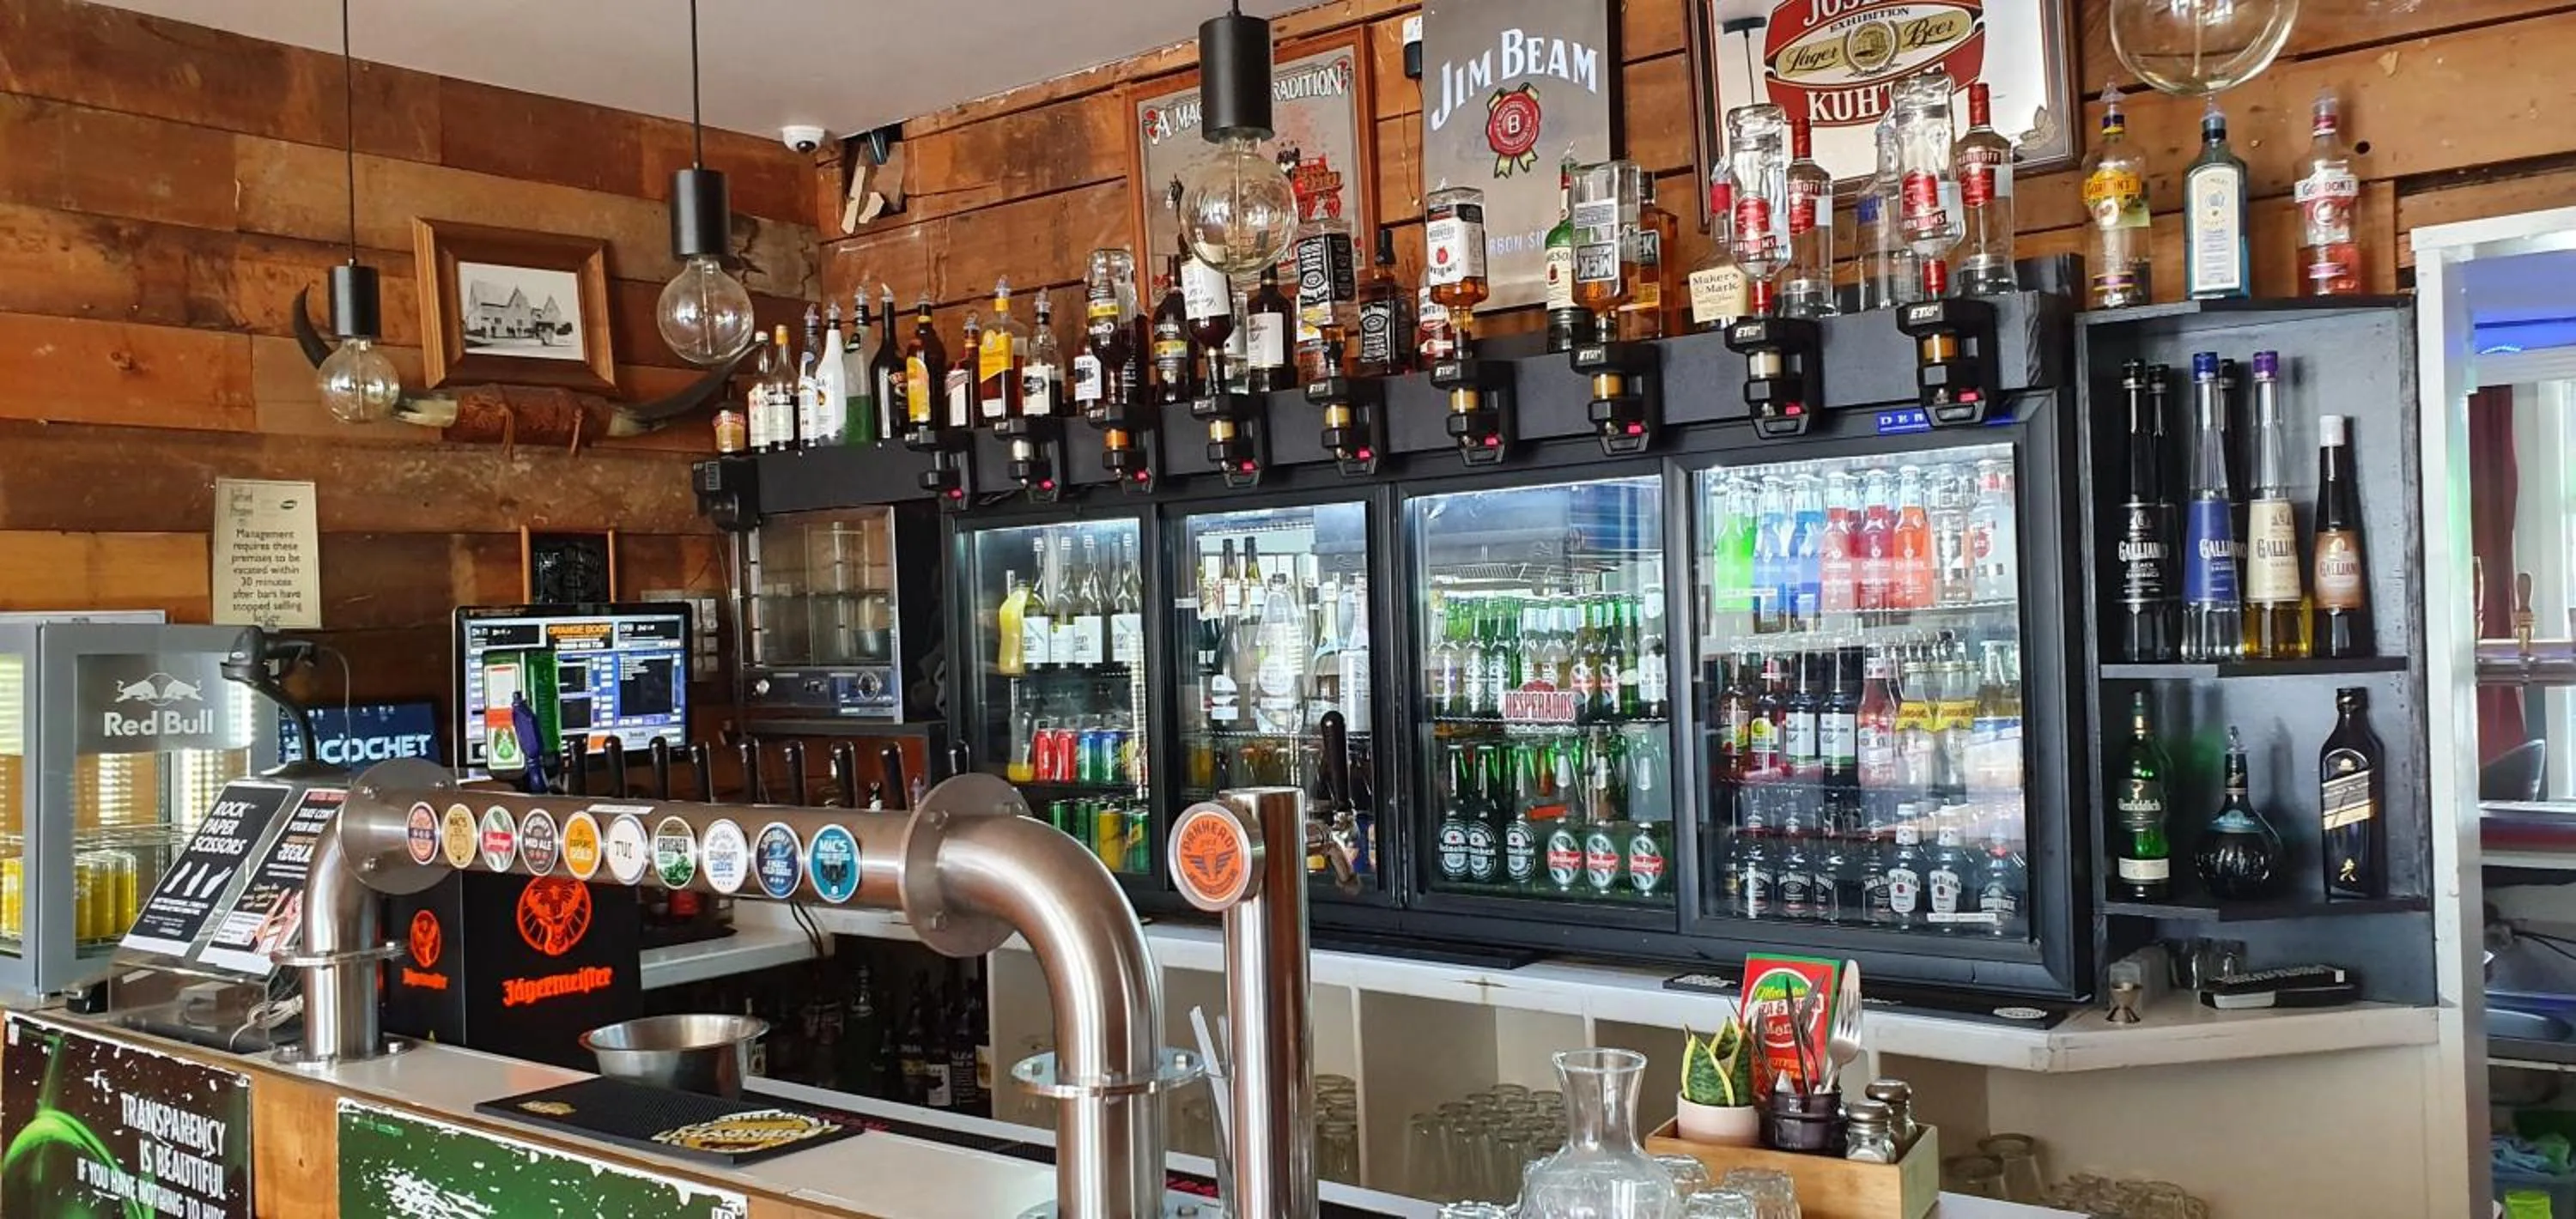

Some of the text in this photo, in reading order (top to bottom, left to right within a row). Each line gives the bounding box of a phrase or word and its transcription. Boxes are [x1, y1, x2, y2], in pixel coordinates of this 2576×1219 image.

[1830, 7, 1910, 33] EXHIBITION
[1903, 17, 1956, 48] Beer
[1431, 27, 1598, 131] JIM BEAM
[1507, 114, 1521, 134] B
[2087, 177, 2130, 195] GORN'S
[2302, 180, 2354, 196] GODON'S
[236, 529, 295, 541] Management
[233, 543, 270, 554] requires
[2257, 537, 2296, 560] GALLI
[231, 554, 301, 565] premises to be
[2319, 561, 2358, 577] GALLIAN
[271, 566, 300, 574] within
[256, 578, 292, 586] minutes
[257, 589, 277, 598] bars
[280, 590, 301, 598] have
[274, 603, 302, 612] selling
[1505, 692, 1575, 720] DESPERADOS
[104, 710, 214, 737] Red Bull
[315, 734, 431, 765] ICOCHET
[213, 801, 247, 818] ROCK
[201, 818, 240, 834] PAPER
[190, 835, 247, 856] SCISSORS
[525, 837, 552, 851] MID ALE
[1182, 820, 1236, 852] PANHEAD
[120, 1092, 226, 1156] TRANSPARENCY
[139, 1138, 226, 1200] IS BEAUTIFUL
[77, 1157, 87, 1182] IF
[88, 1160, 110, 1190] YOU
[111, 1168, 136, 1199] HAVE
[138, 1177, 184, 1219] NOTHING
[185, 1196, 200, 1219] TO
